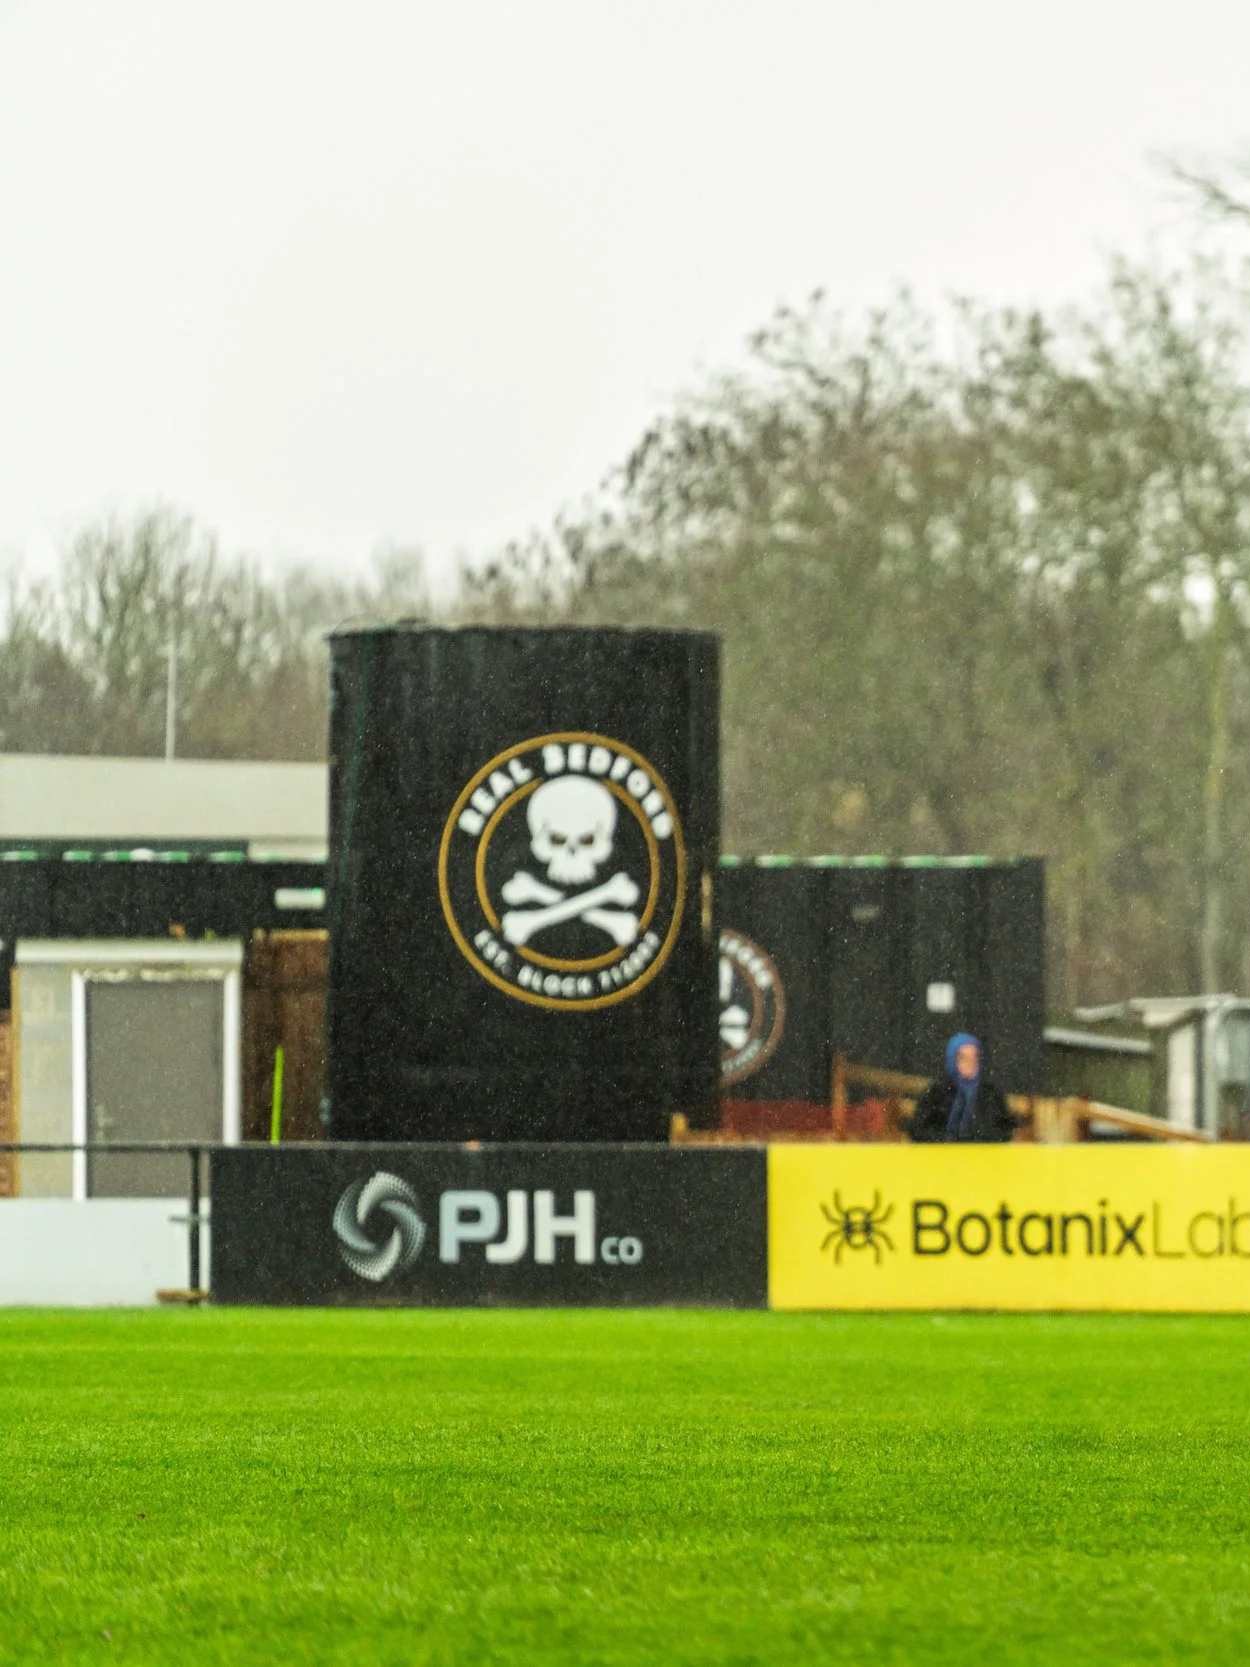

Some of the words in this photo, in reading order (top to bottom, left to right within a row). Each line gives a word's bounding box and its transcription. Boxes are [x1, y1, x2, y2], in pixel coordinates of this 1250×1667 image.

[457, 757, 534, 836] REAL
[541, 742, 674, 840] BEDFORD
[516, 964, 593, 998] BLOCK
[438, 1188, 596, 1265] PJH
